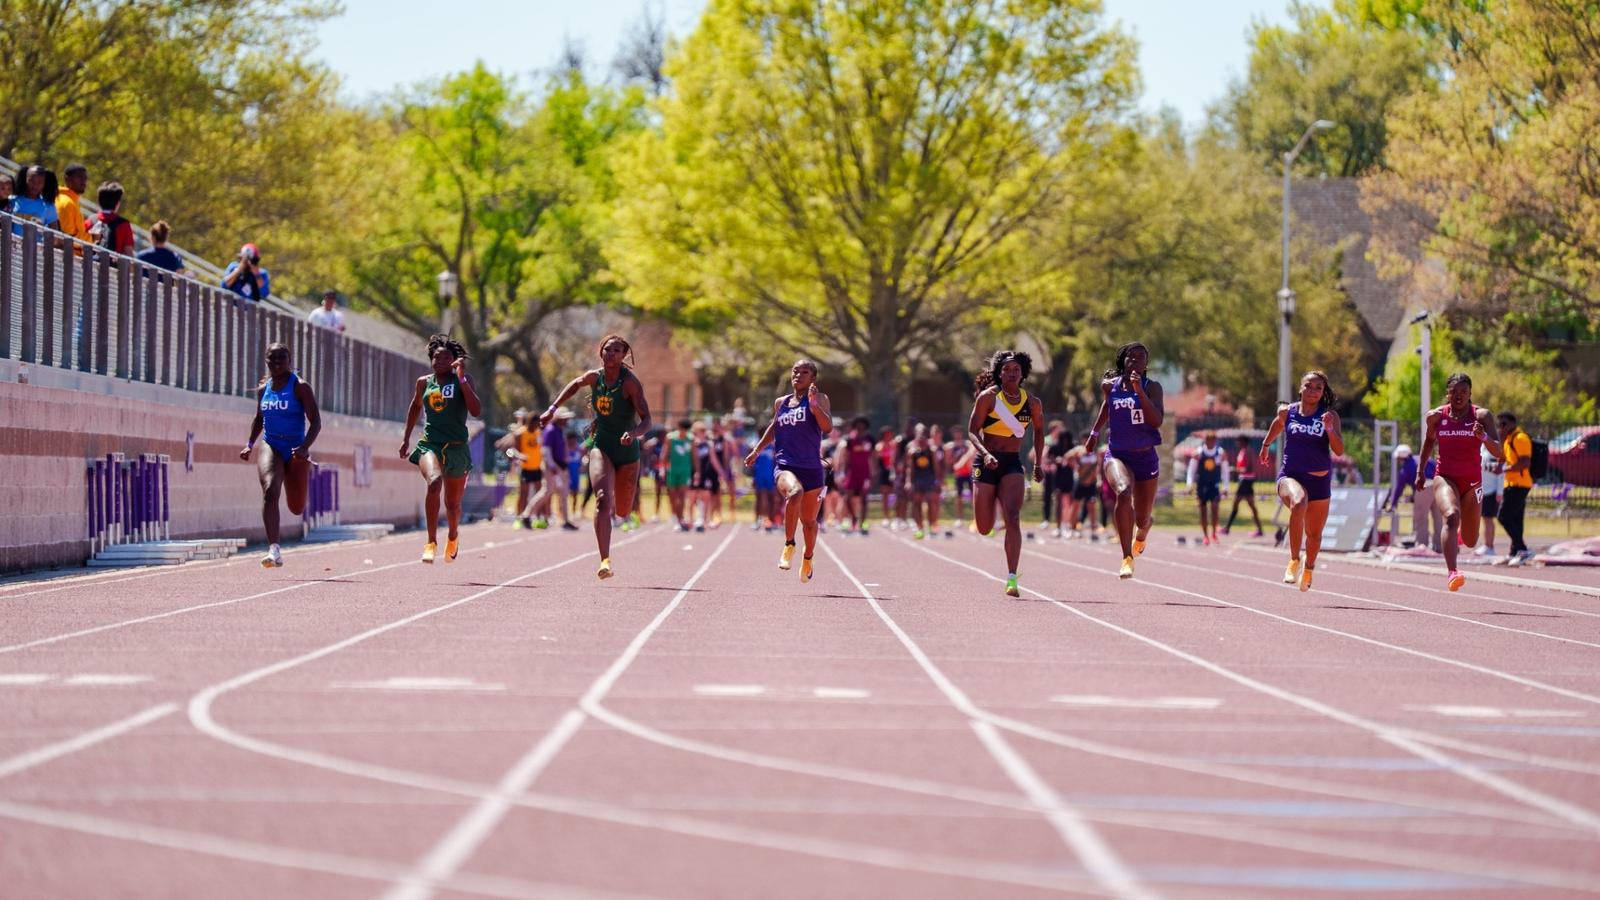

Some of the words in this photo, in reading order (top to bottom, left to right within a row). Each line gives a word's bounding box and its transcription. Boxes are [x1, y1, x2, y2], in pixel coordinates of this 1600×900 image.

[260, 400, 289, 410] SMU
[1113, 396, 1136, 410] TCU
[1133, 410, 1142, 422] 4
[1439, 429, 1475, 437] OKLAHOMA
